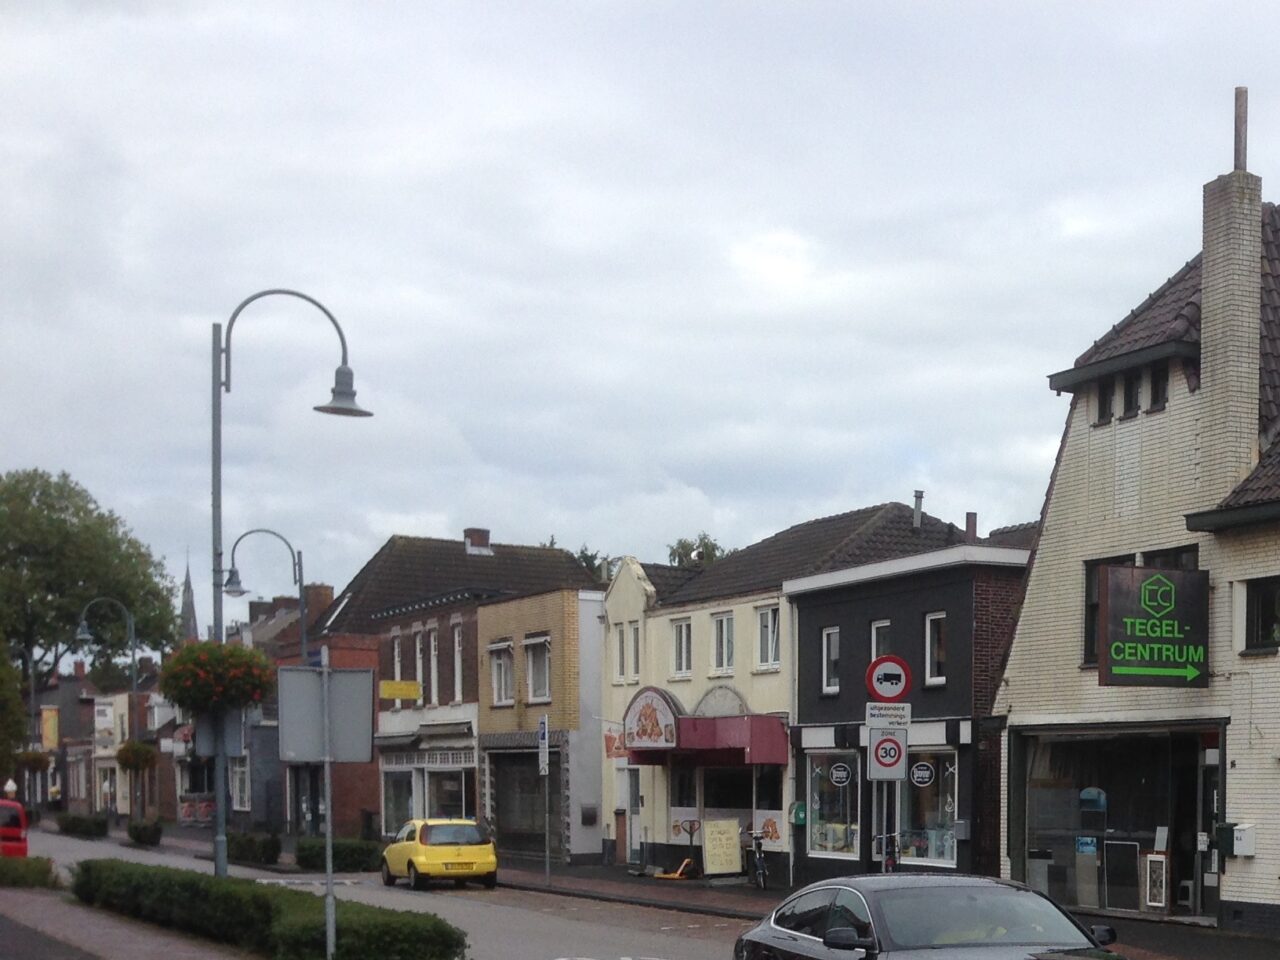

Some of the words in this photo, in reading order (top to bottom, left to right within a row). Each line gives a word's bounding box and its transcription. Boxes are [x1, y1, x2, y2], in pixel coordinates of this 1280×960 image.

[1122, 618, 1191, 638] TEGEL-
[1110, 642, 1205, 663] CENTRUM
[880, 746, 897, 759] 30
